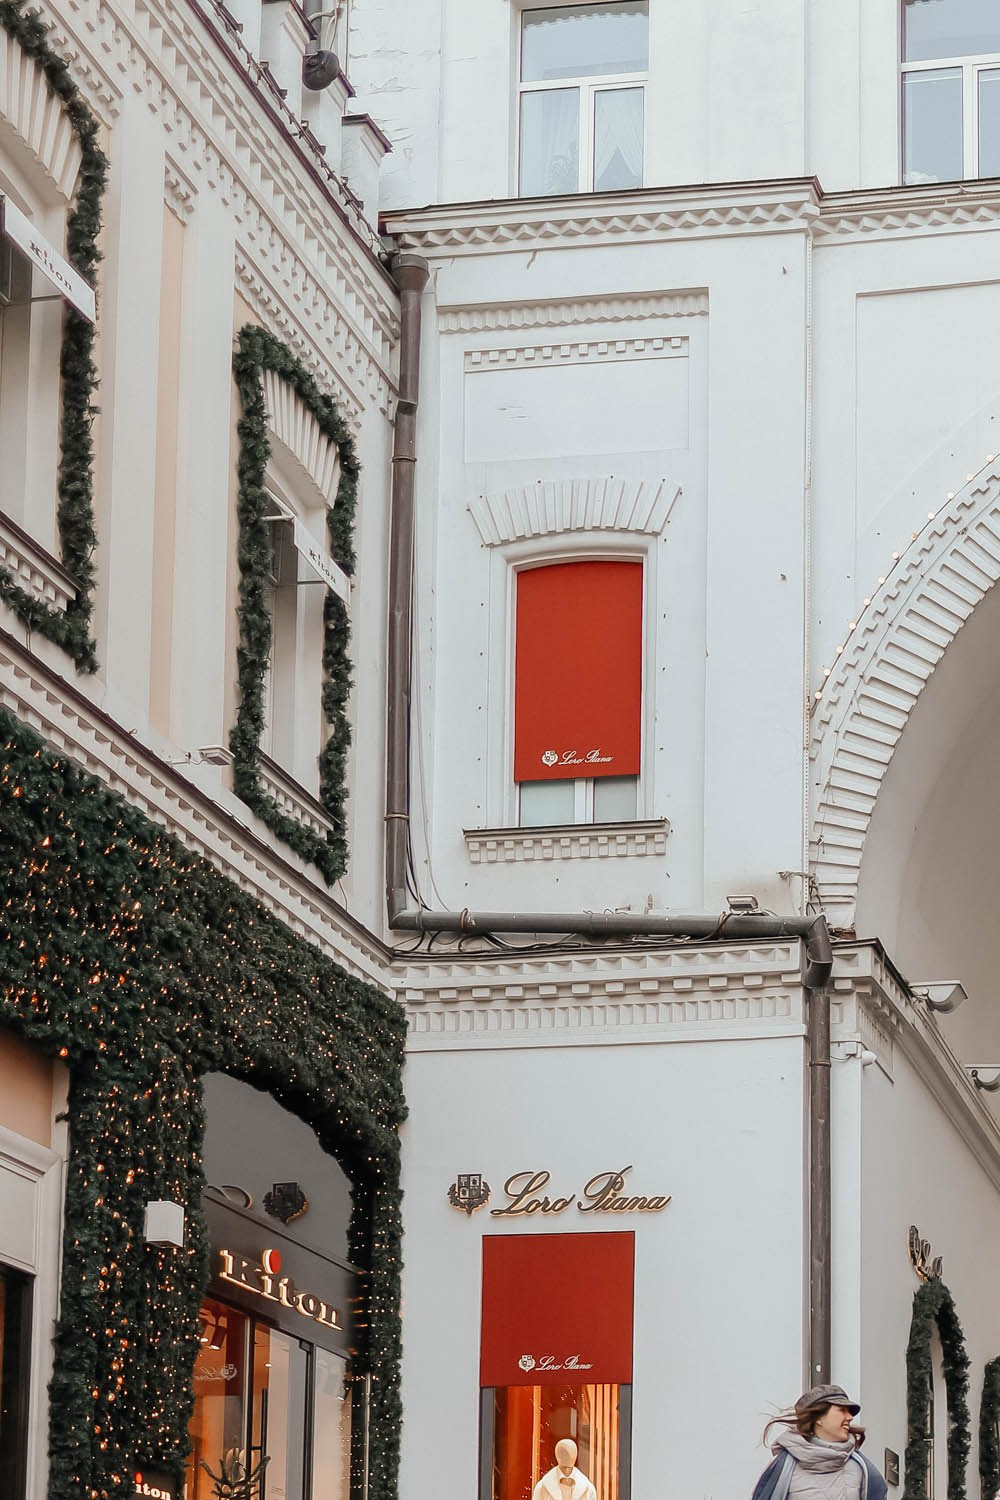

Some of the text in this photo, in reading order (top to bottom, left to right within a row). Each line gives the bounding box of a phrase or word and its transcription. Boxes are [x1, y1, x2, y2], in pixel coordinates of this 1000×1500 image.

[30, 239, 73, 293] Kiton
[309, 547, 337, 585] Kiton
[557, 747, 613, 765] Loro Piana
[489, 1164, 672, 1216] Loro Piana
[219, 1248, 343, 1331] Kiton
[535, 1353, 593, 1371] Loro Piana
